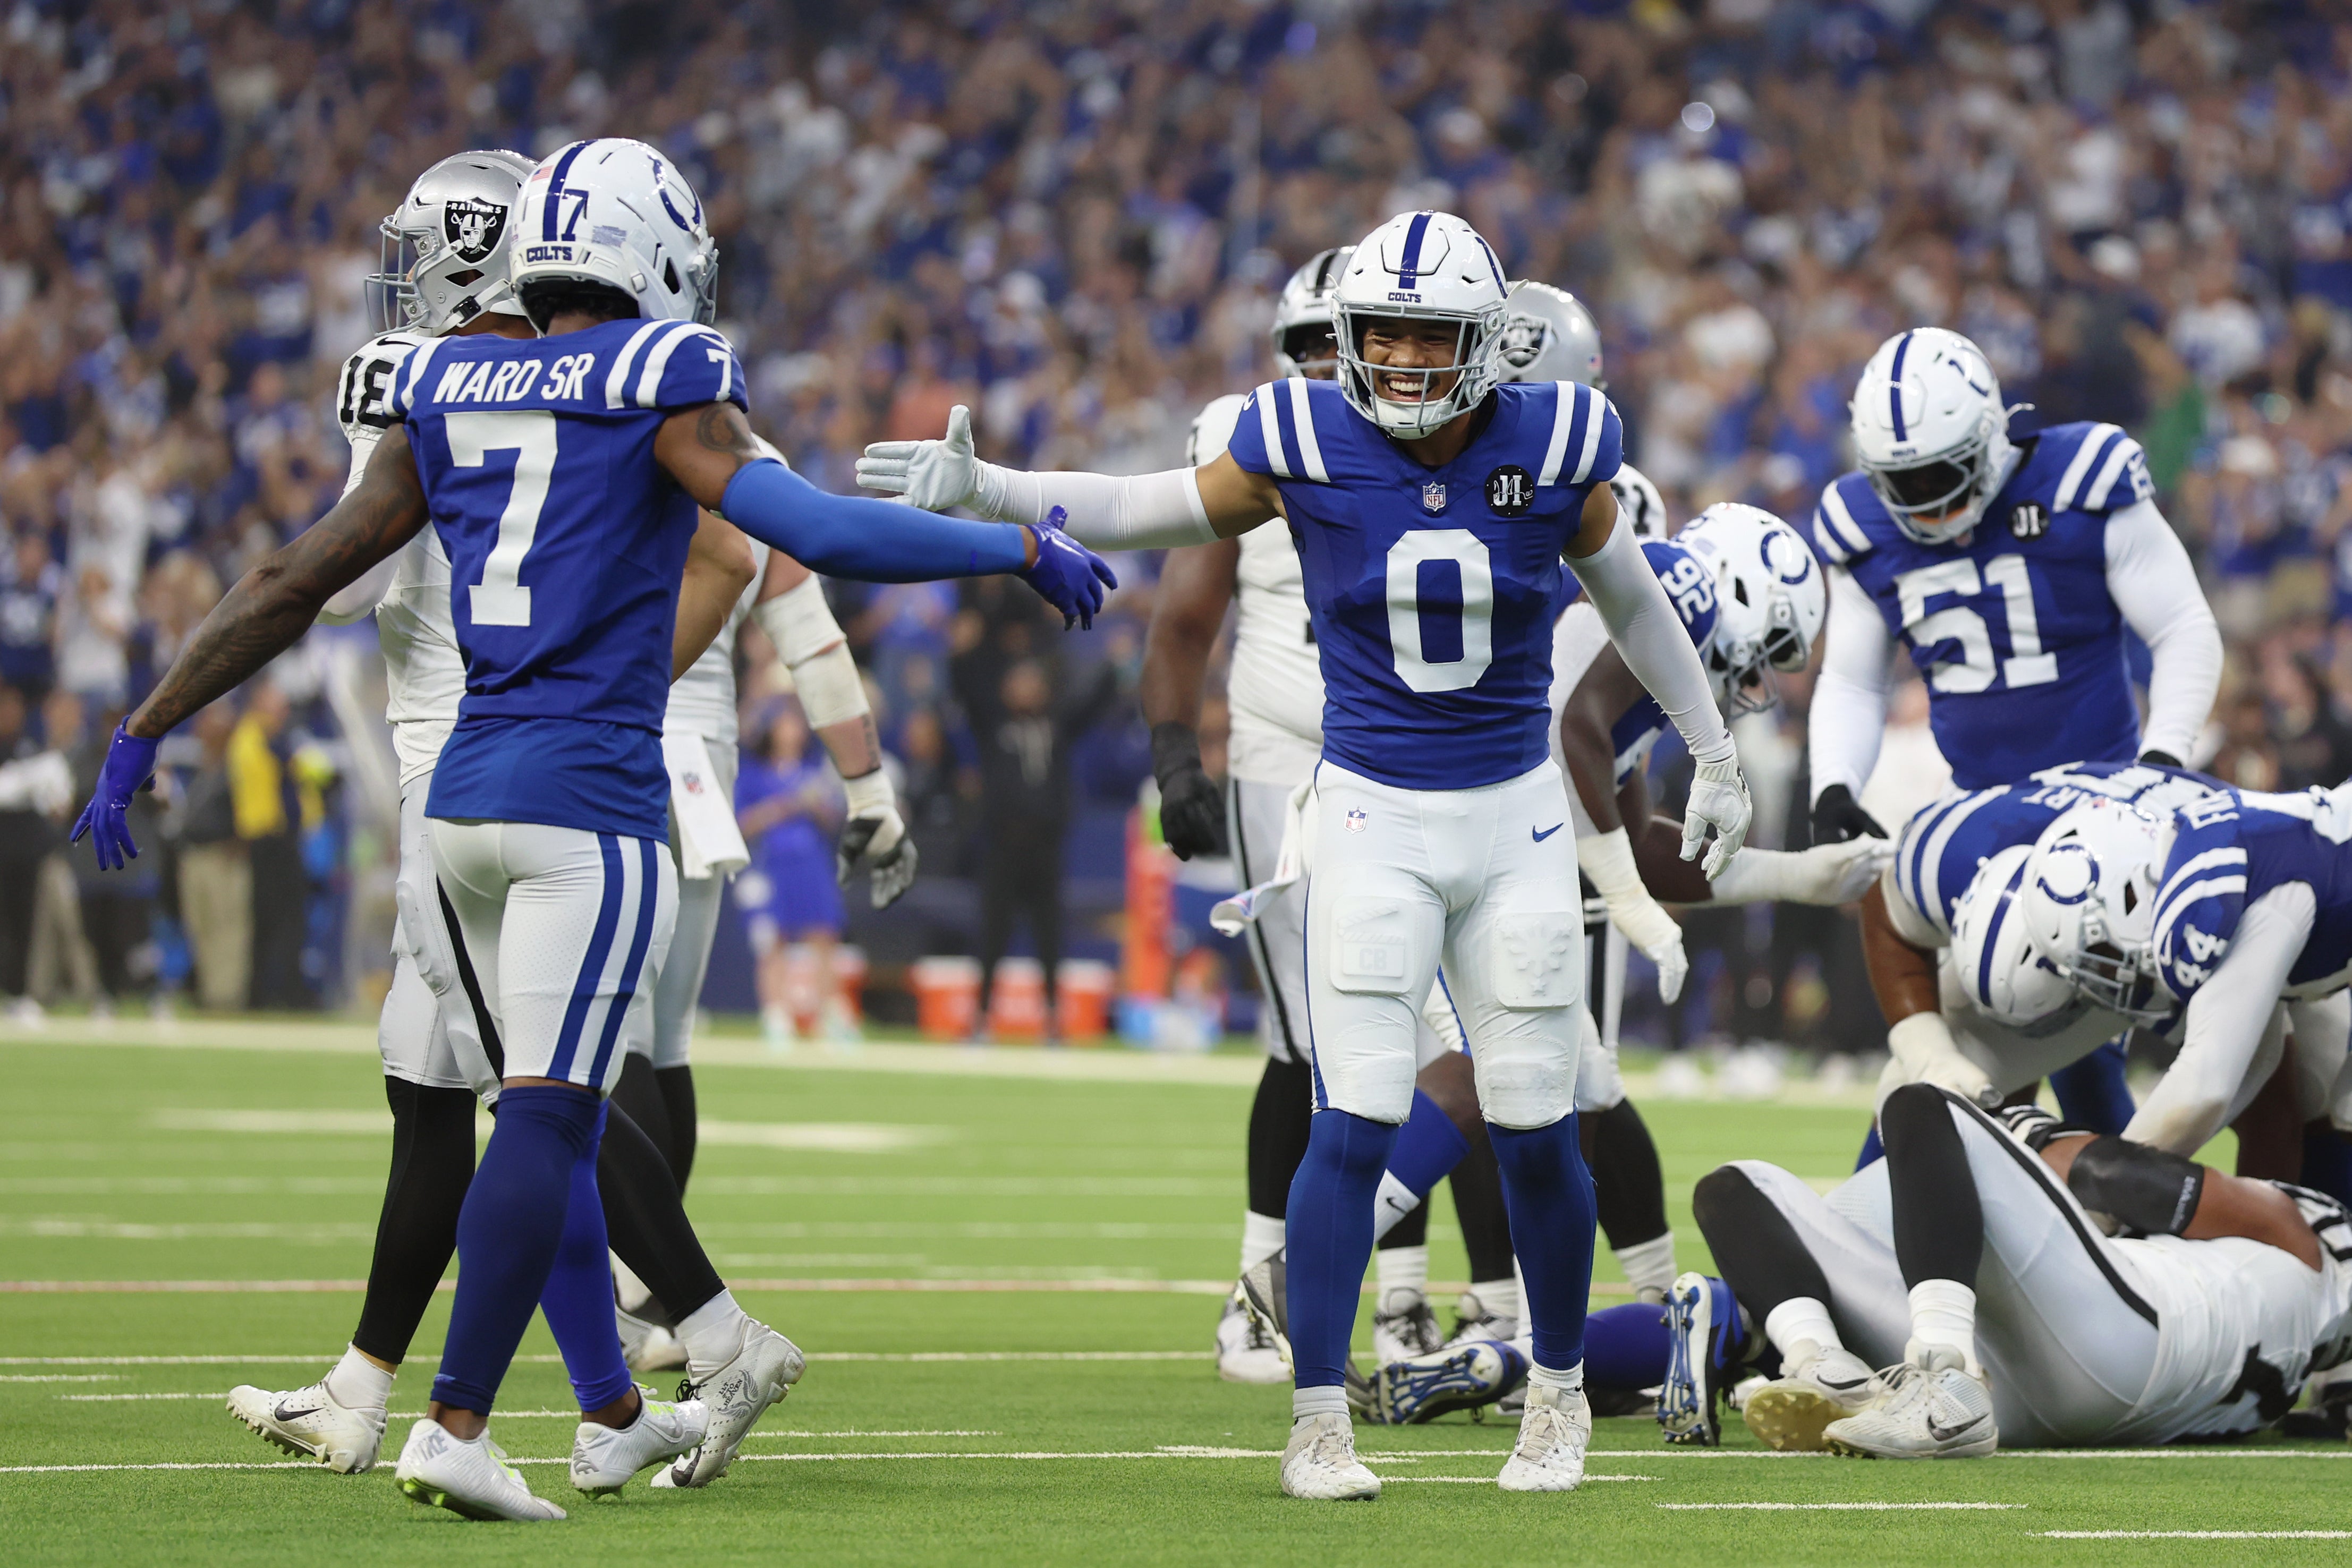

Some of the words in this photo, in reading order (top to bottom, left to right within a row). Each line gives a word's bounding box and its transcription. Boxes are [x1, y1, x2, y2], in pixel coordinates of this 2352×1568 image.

[451, 202, 502, 214] RAIDERS
[561, 189, 589, 241] 7
[526, 245, 572, 262] COLTS
[1388, 292, 1421, 303] COLTS
[432, 359, 543, 403] WARD
[541, 353, 596, 400] SR
[706, 348, 732, 402] 7
[444, 410, 558, 626] 7
[1427, 495, 1442, 505] NFL
[1387, 529, 1493, 693] 0
[1659, 557, 1714, 625] 92
[1893, 553, 2059, 694] 51
[2173, 923, 2228, 987] 44
[723, 1378, 743, 1407] HEAVEN
[726, 1383, 734, 1393] TO
